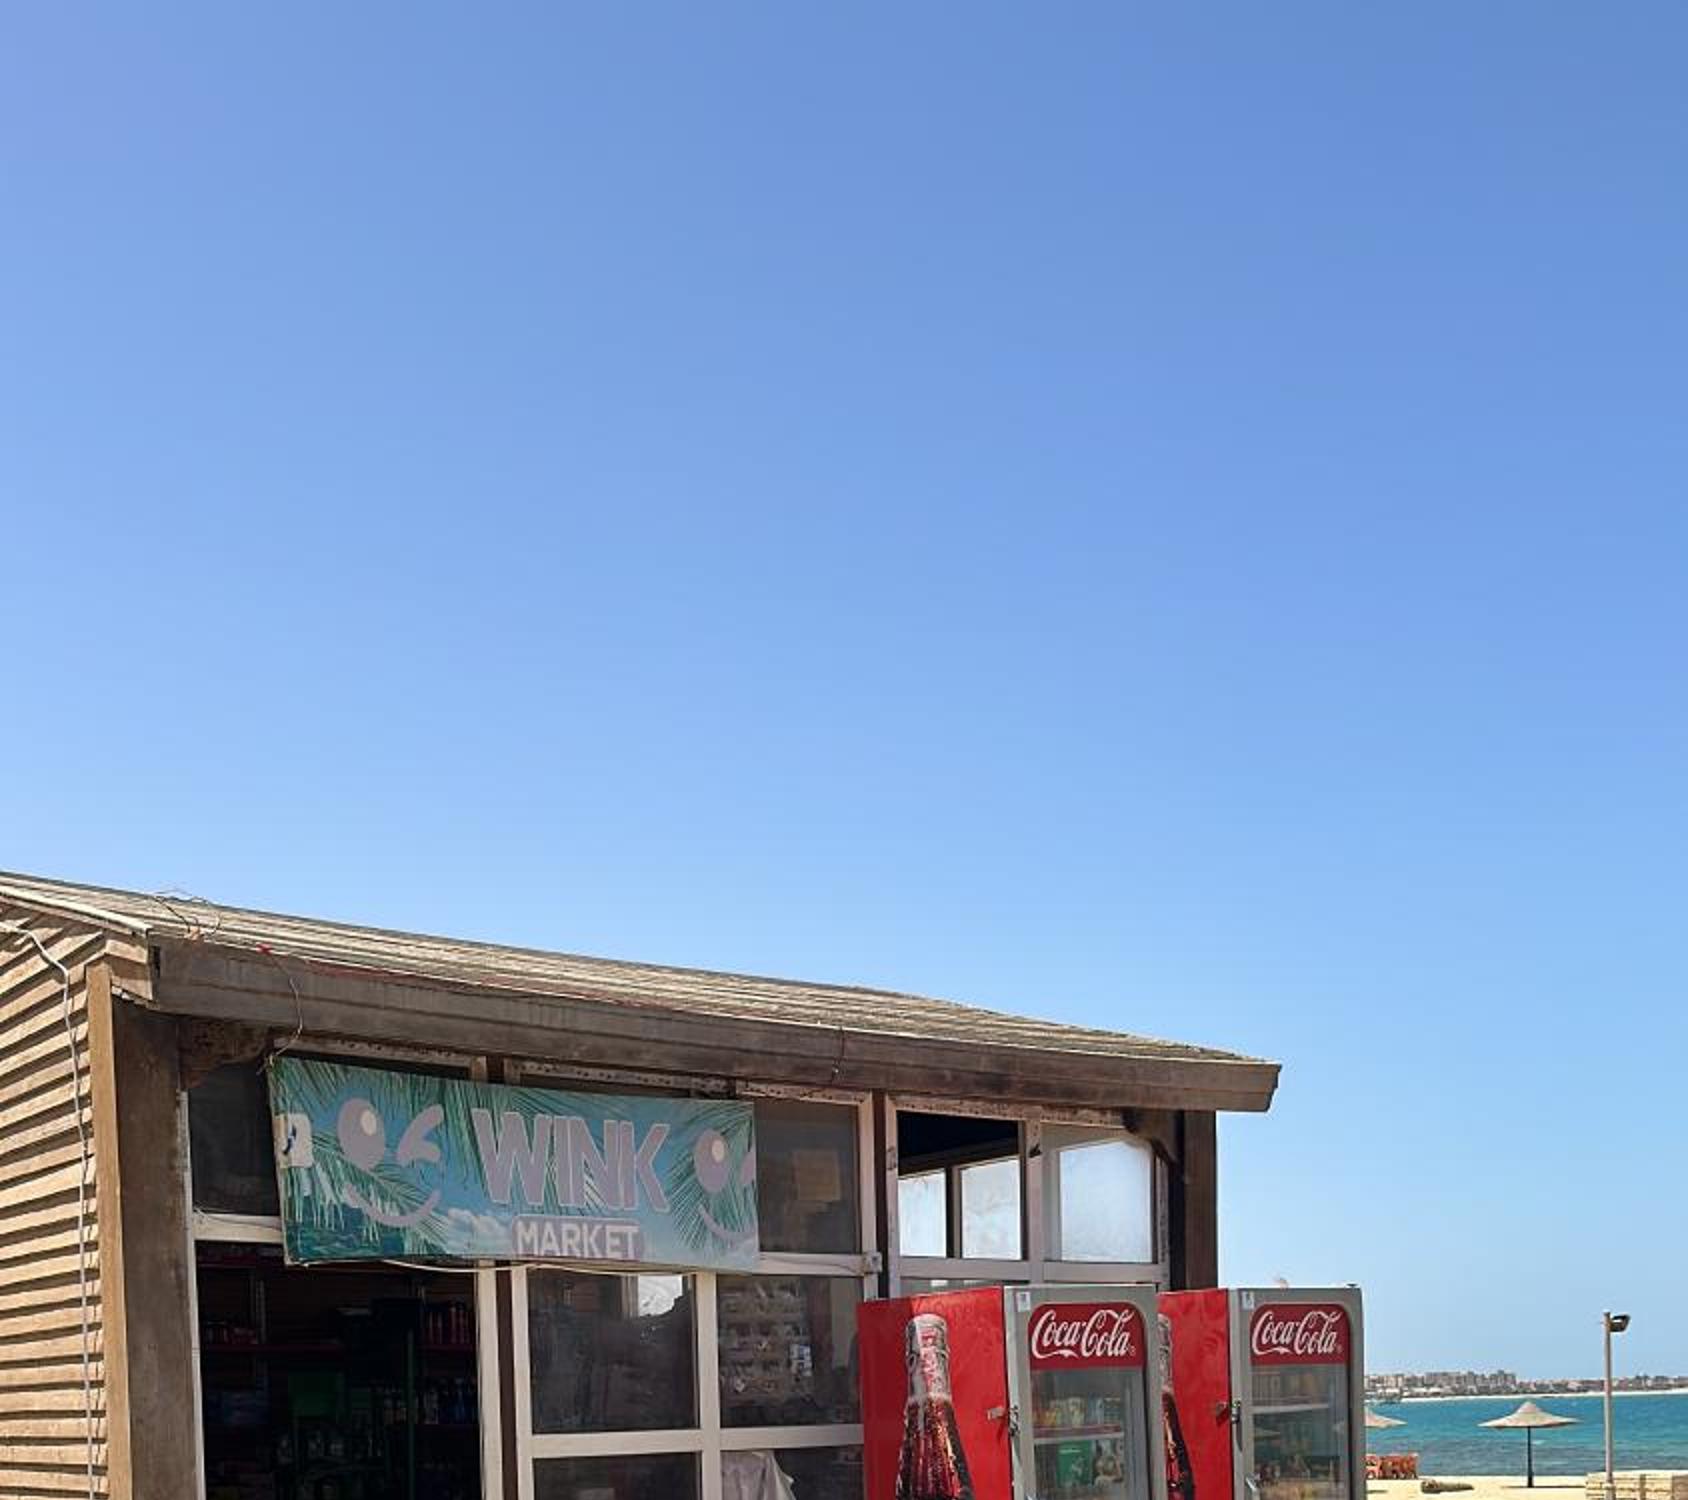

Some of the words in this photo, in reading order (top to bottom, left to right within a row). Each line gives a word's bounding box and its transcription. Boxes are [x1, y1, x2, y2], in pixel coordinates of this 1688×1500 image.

[471, 1108, 671, 1213] WINK
[516, 1221, 640, 1259] MARKET
[1032, 1309, 1134, 1359] Coca-Cola
[1252, 1311, 1342, 1355] Coca-Cola
